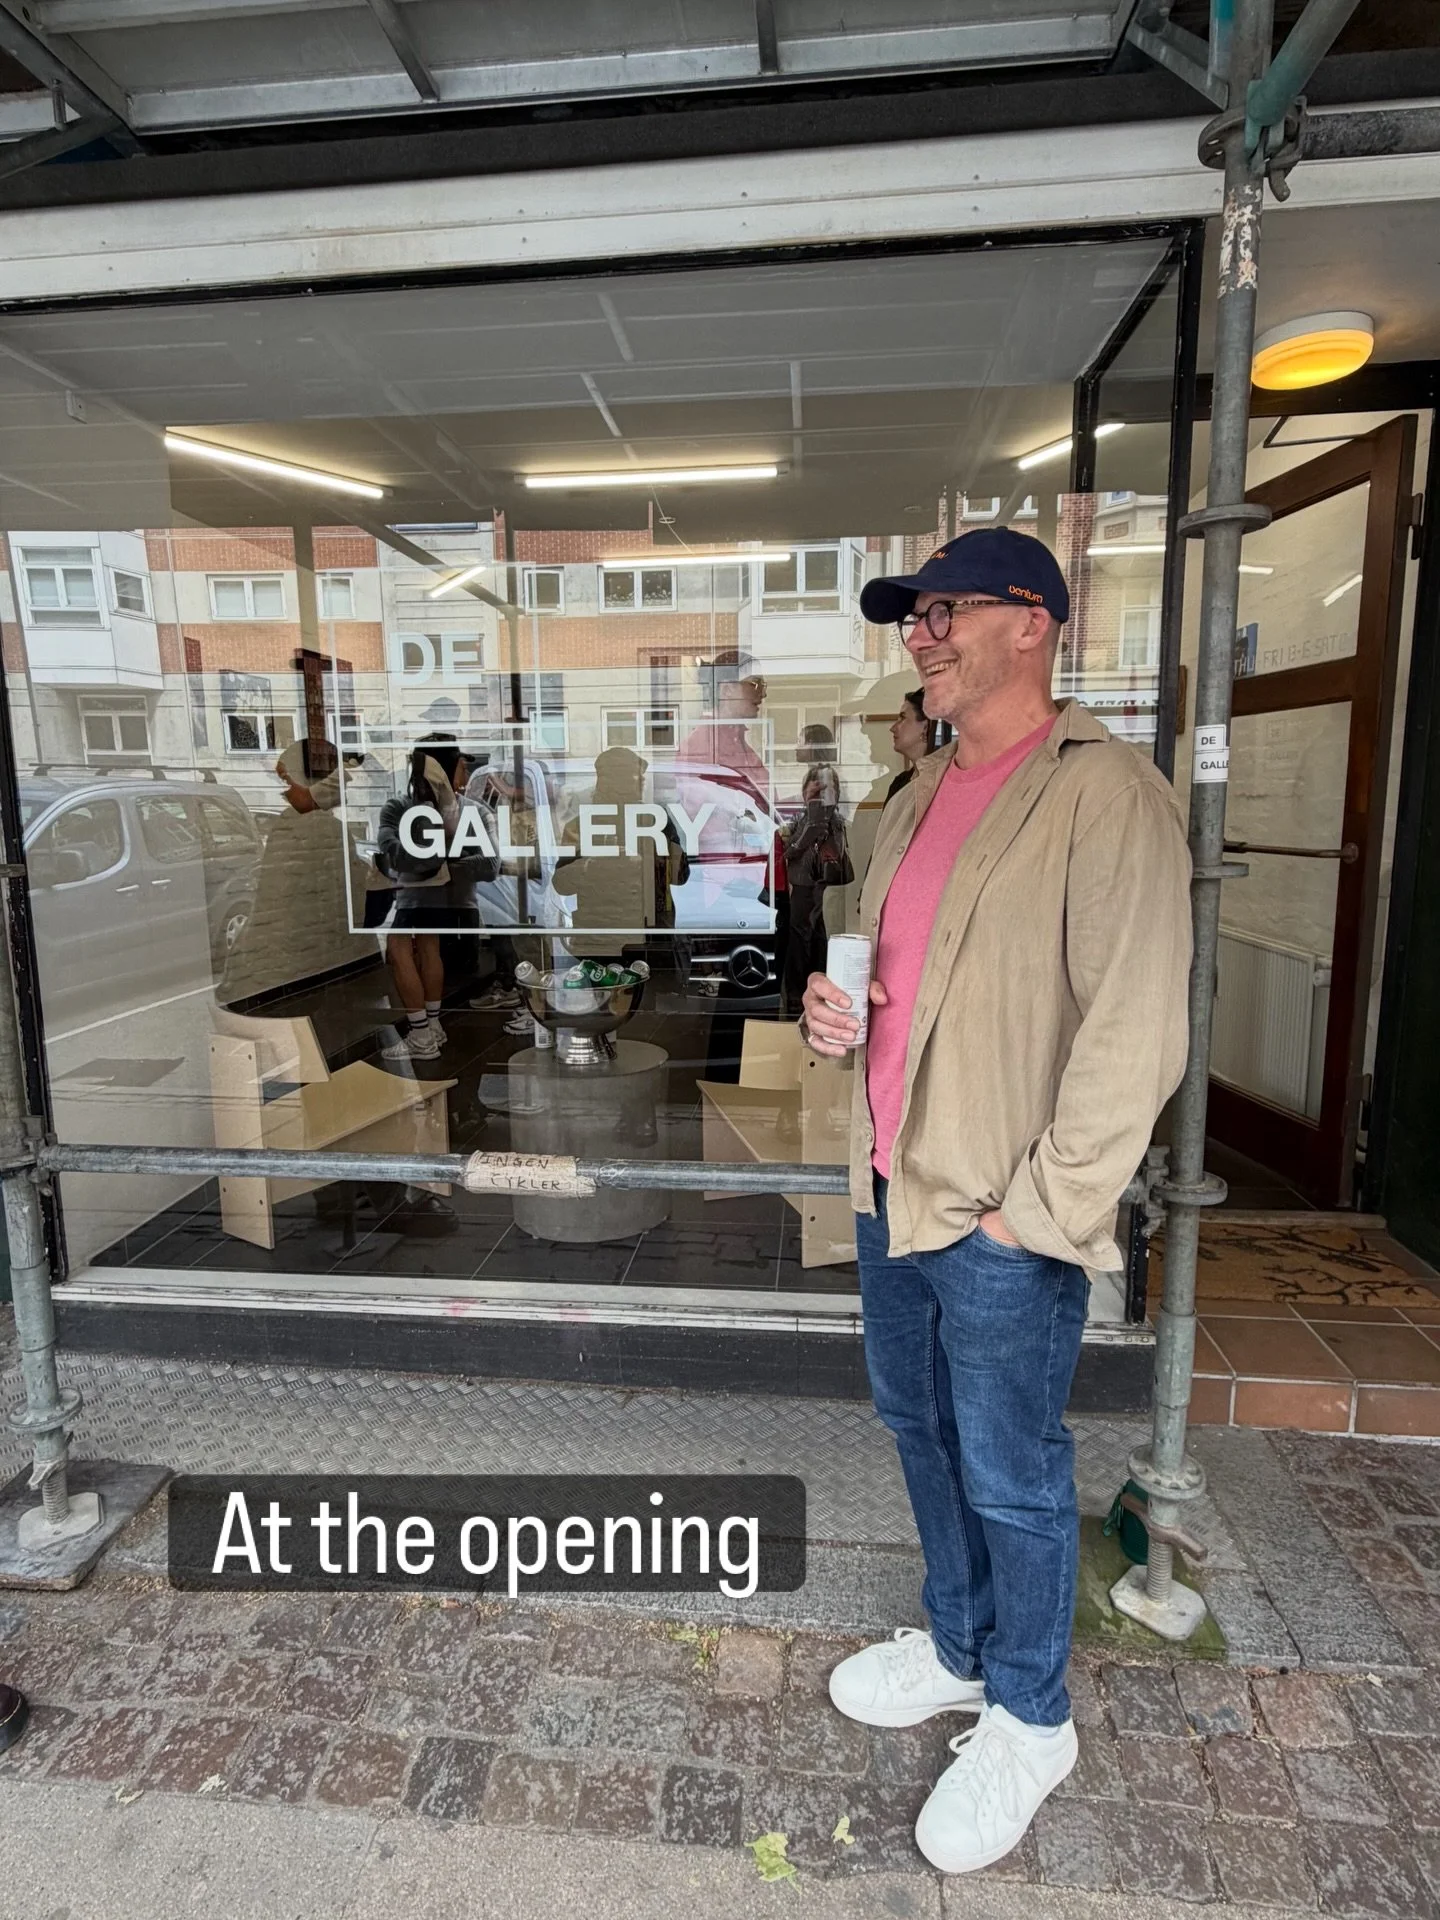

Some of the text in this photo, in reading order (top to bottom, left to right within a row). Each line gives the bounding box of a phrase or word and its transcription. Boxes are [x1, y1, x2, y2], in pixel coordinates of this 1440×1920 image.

[389, 631, 482, 685] DE
[1200, 736, 1217, 746] DE
[398, 803, 717, 860] GALLERY
[479, 1154, 549, 1169] INGEN
[490, 1173, 562, 1191] CYKLER
